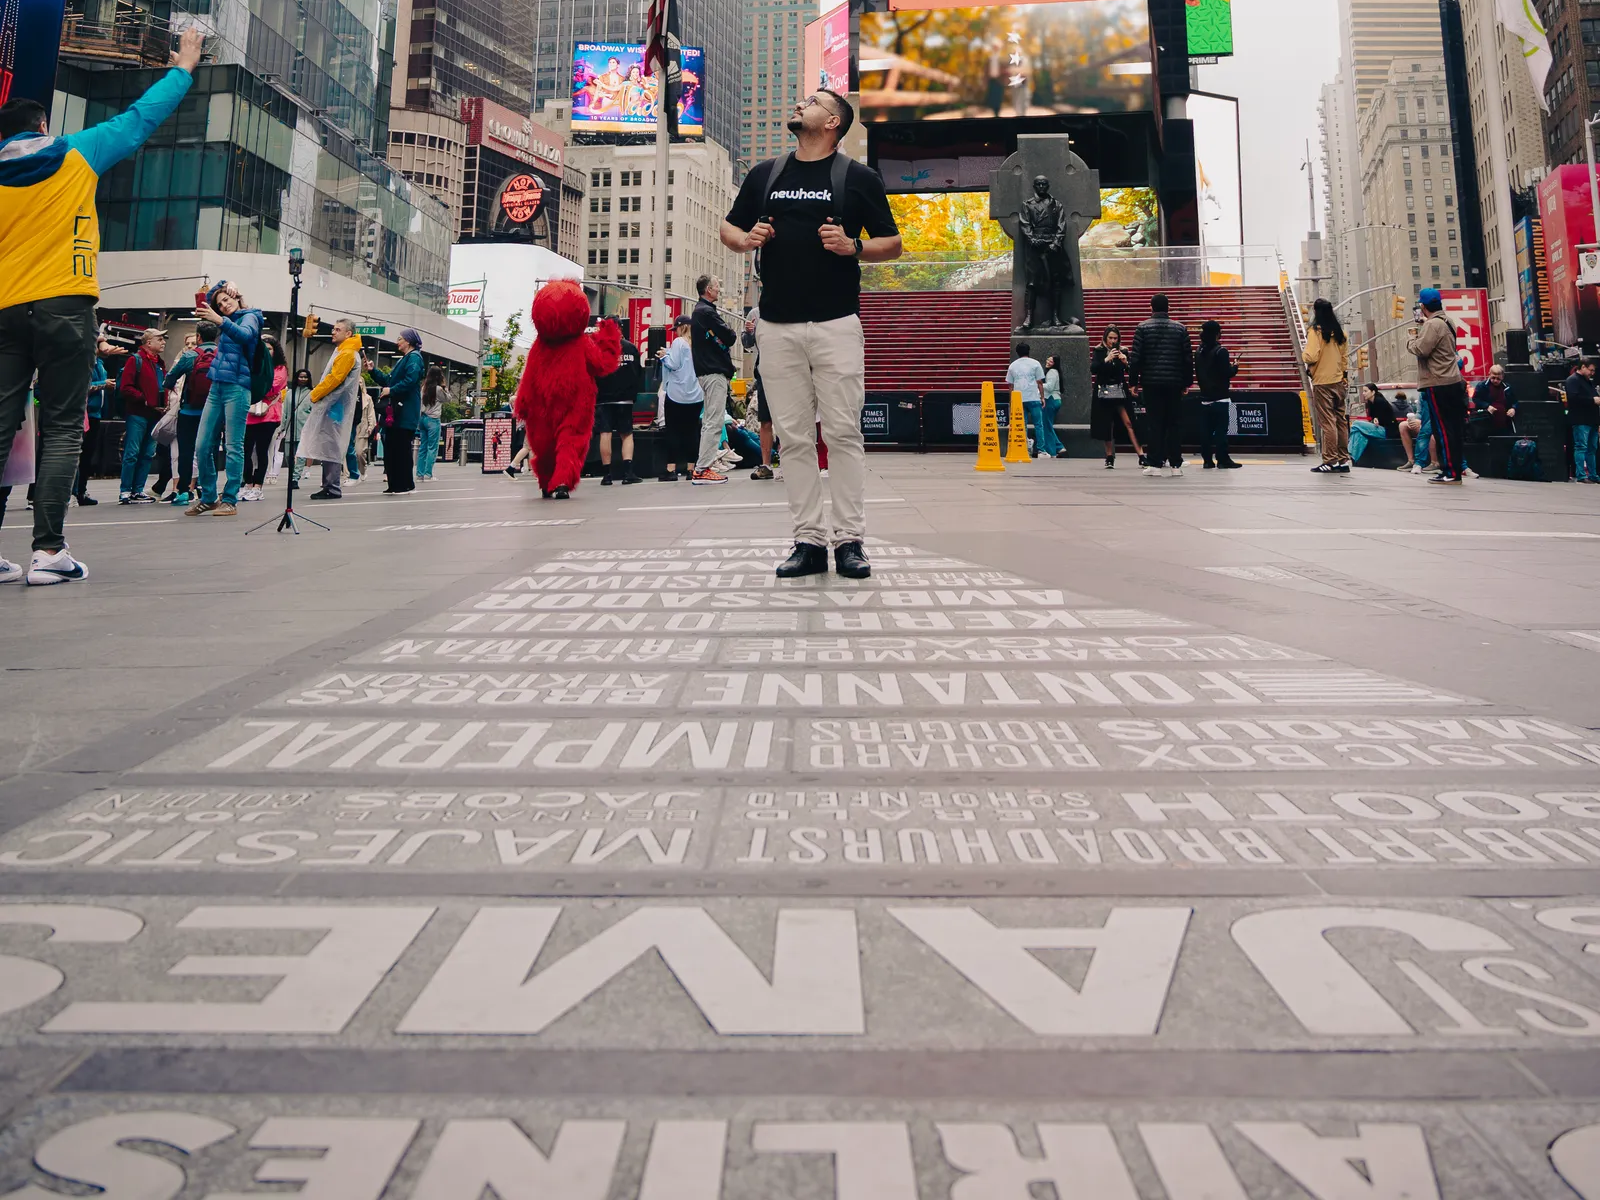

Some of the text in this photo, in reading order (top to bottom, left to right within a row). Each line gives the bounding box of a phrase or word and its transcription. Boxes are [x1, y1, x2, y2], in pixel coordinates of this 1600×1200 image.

[578, 44, 624, 53] BROADWAY
[513, 178, 532, 190] HOT
[770, 188, 832, 201] newhack
[511, 206, 531, 219] NOW
[692, 546, 914, 558] BRWAY
[533, 560, 903, 573] SMON
[502, 574, 817, 590] GERSHWIN
[472, 590, 1065, 609] AMBASSADOR
[446, 611, 716, 632] O'NEILL
[824, 610, 1087, 629] KERR
[379, 639, 712, 655] FRIEDMAN
[734, 636, 1252, 649] LONGACRE
[445, 653, 703, 663] SAMUEL
[725, 648, 1140, 663] BARRYMORE
[312, 673, 672, 689] ATKINSON
[692, 671, 1263, 705] FONTANNE
[286, 688, 665, 705] BROOKS
[810, 720, 1080, 742] RODGERS
[1098, 719, 1588, 741] MARQUIS
[204, 721, 777, 769] IMPERIAL
[808, 743, 1100, 768] RICHARD
[1117, 743, 1329, 767] BOX
[93, 791, 313, 809] GOLDEN
[337, 791, 702, 809] JACOBS
[746, 791, 1092, 809] SCHOENFELD
[66, 810, 283, 823] JOHN
[418, 809, 699, 822] BERNARD
[745, 809, 1100, 822] GERALD
[2, 827, 695, 866] MAJESTIC
[736, 827, 1285, 866] BROADHURST
[1305, 828, 1600, 864] UBERT
[30, 1110, 1440, 1200] AIRLINES
